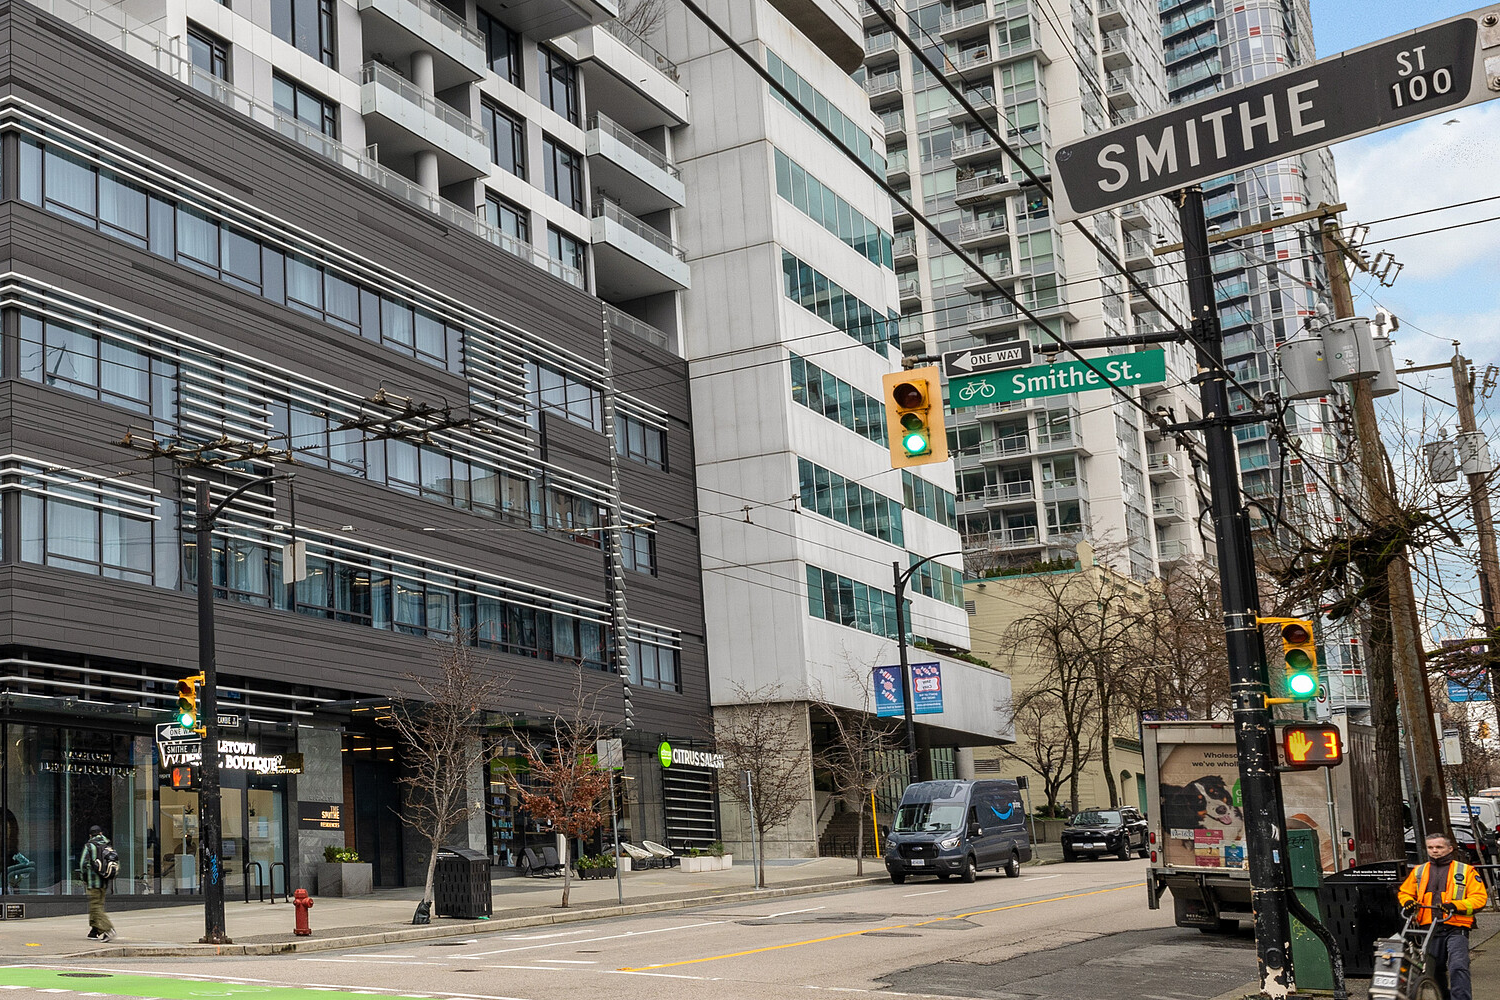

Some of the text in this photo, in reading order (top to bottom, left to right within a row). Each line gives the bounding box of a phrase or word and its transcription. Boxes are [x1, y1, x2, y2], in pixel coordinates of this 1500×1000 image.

[1396, 45, 1427, 77] ST
[1392, 67, 1452, 108] 100
[1097, 79, 1326, 193] SMITHE
[970, 348, 1021, 366] ONE WAY
[1012, 361, 1142, 395] Smithe St.
[169, 727, 182, 736] ONE
[166, 745, 188, 754] SMITHE
[217, 740, 256, 756] LETOWN
[1203, 751, 1238, 759] Wholeso
[1323, 732, 1338, 758] 3
[225, 755, 277, 774] BOUTIQUE
[672, 748, 699, 767] CITRUS
[700, 751, 724, 769] SALON
